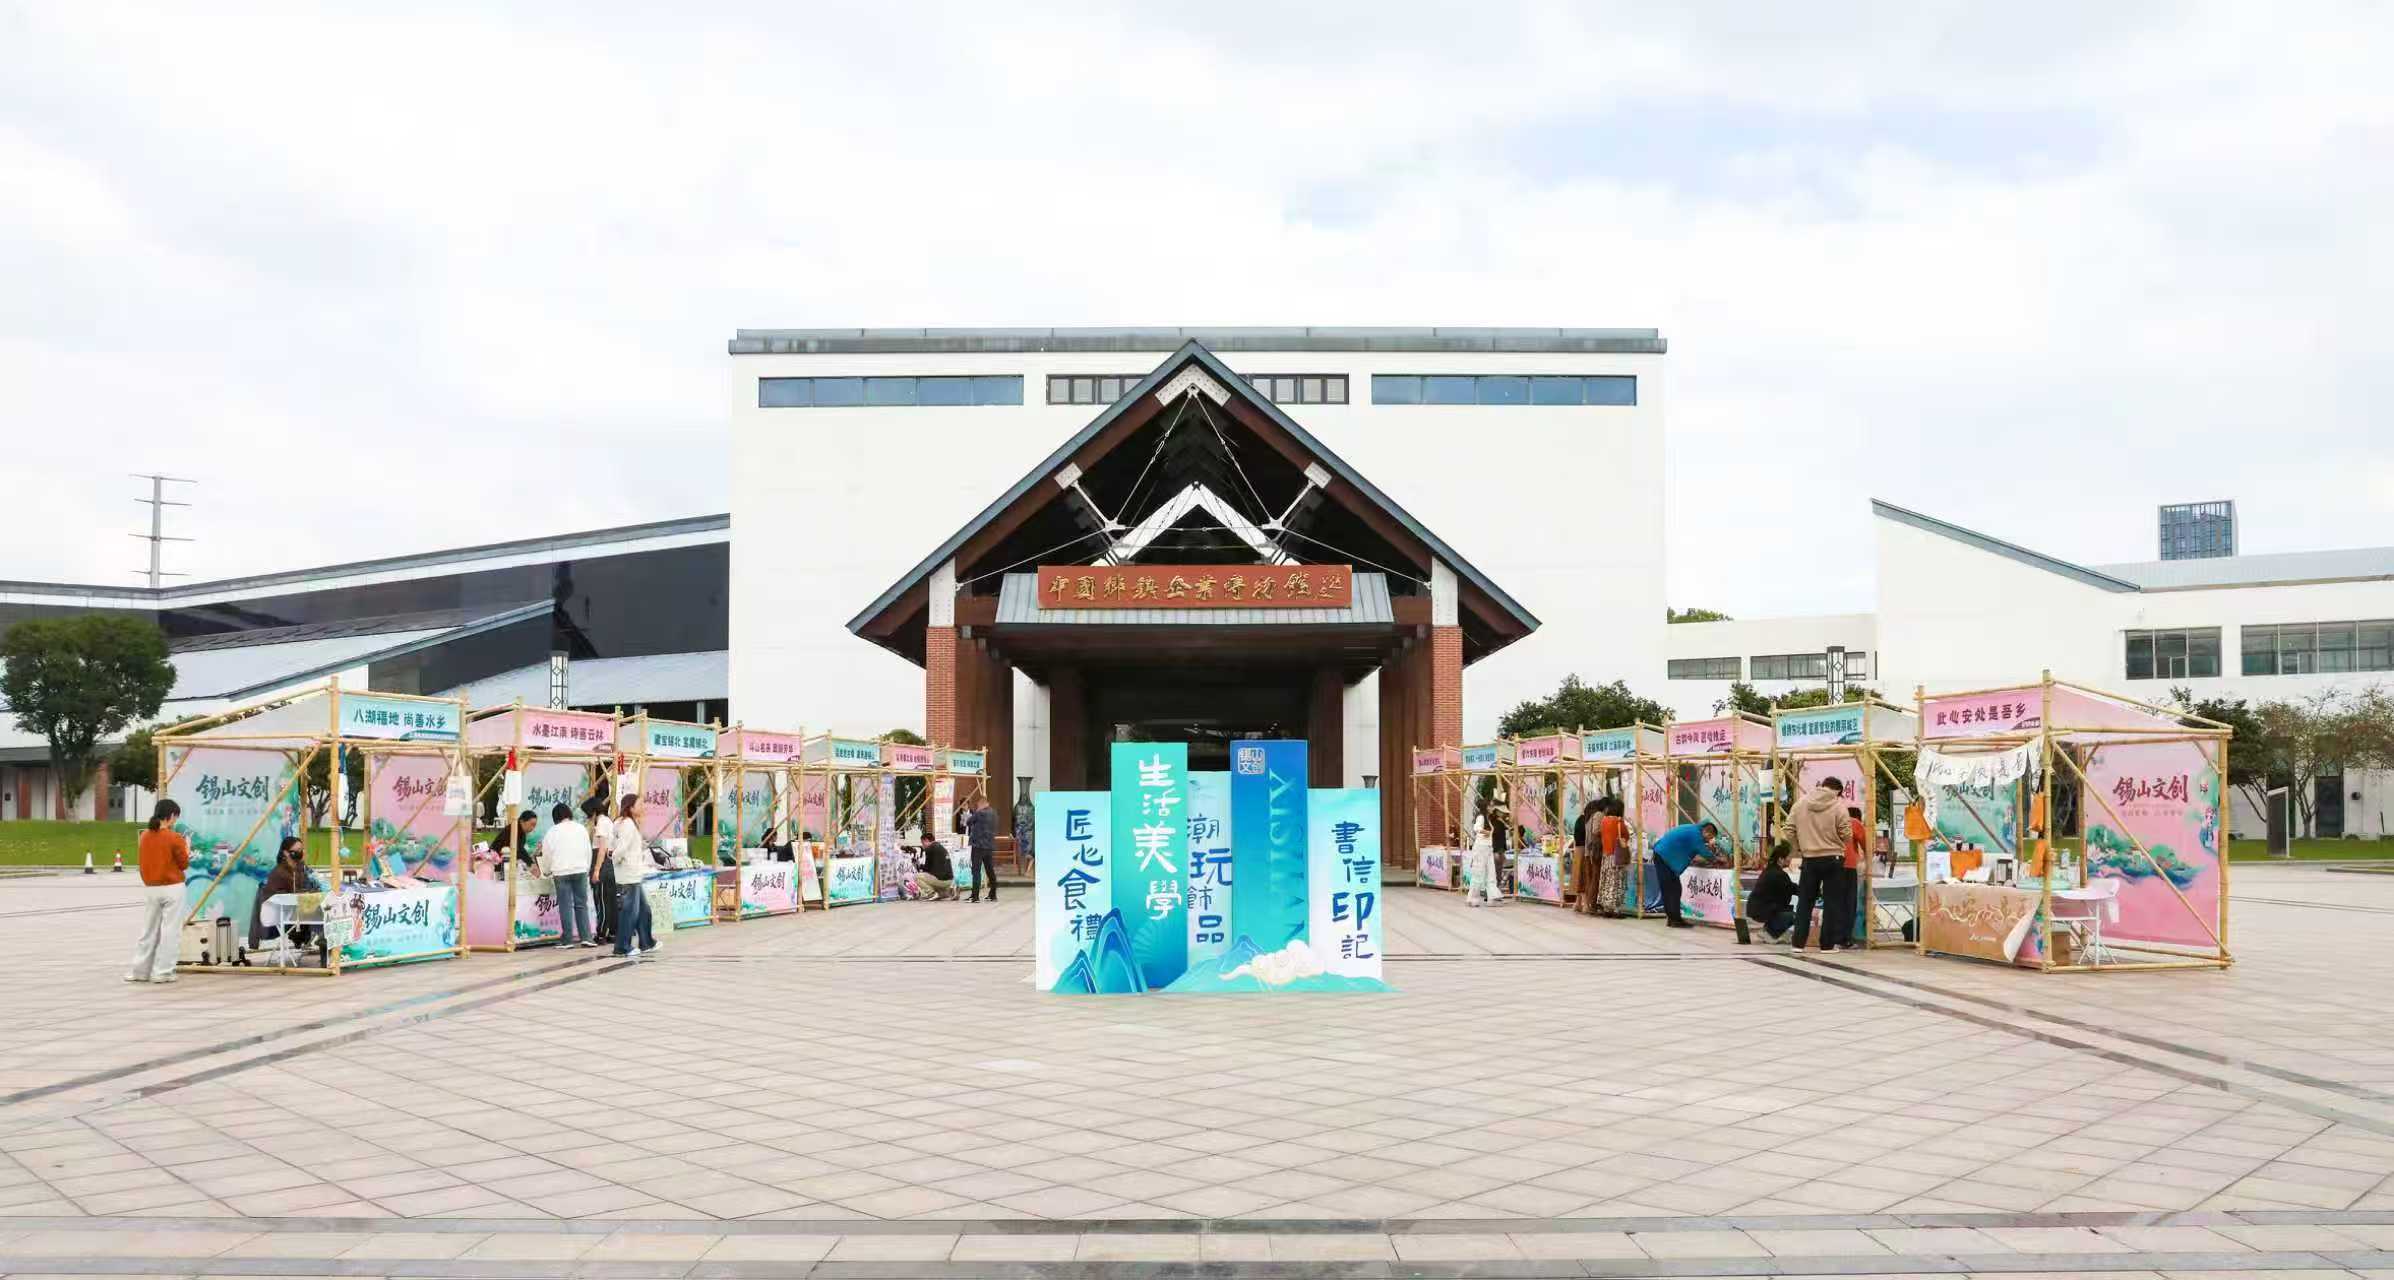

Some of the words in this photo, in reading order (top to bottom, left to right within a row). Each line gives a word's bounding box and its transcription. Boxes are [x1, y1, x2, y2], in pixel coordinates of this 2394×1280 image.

[353, 708, 400, 726] 八湖福地
[403, 711, 446, 729] 尚善水乡
[1936, 702, 2026, 726] 此心安处是吾乡
[195, 774, 270, 807] 锡山文创
[2112, 774, 2189, 807] 锡山文创
[1132, 752, 1183, 920] 生活美學
[750, 871, 786, 896] 锡山文创
[1057, 809, 1104, 943] 匠心食禮
[1187, 812, 1233, 945] 潮玩飾品
[1331, 820, 1376, 960] 書信印記
[1686, 874, 1723, 901] 锡山文创
[363, 899, 430, 935] 锡山文创
